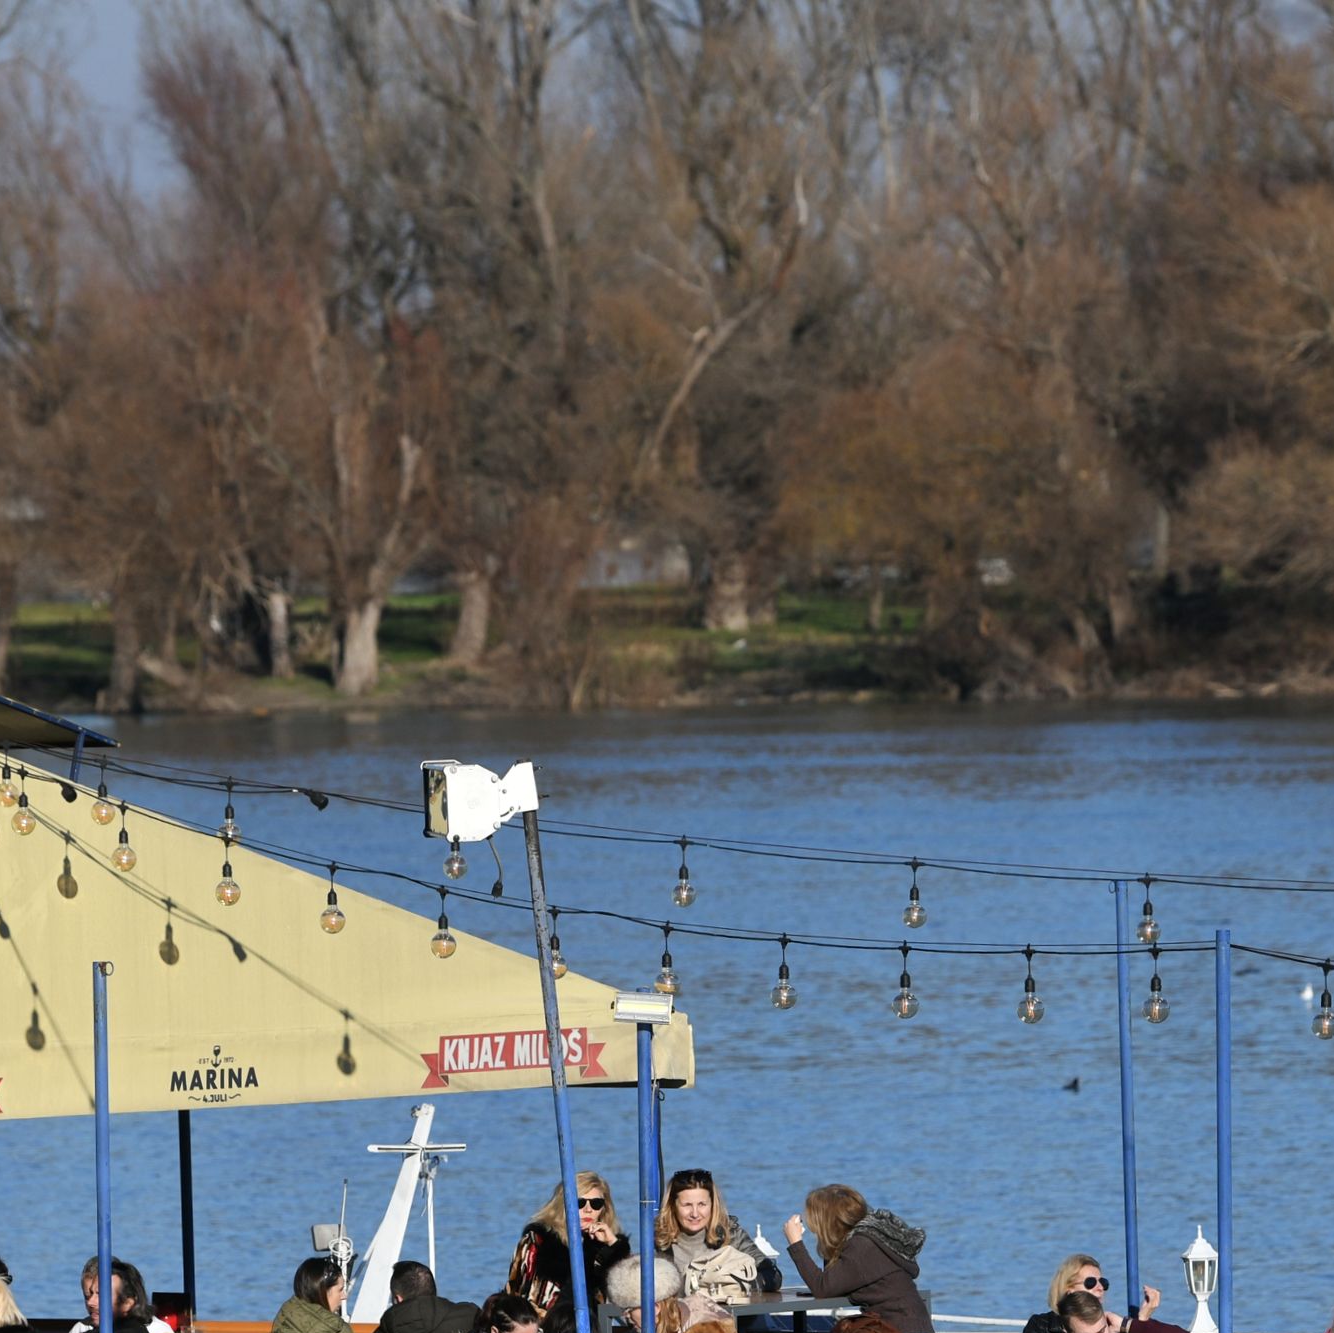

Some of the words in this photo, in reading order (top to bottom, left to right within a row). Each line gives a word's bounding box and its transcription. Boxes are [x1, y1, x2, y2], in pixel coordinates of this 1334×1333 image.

[444, 1035, 506, 1071] KNJAZ
[170, 1066, 259, 1092] MARINA
[202, 1093, 227, 1103] 4.JULI
